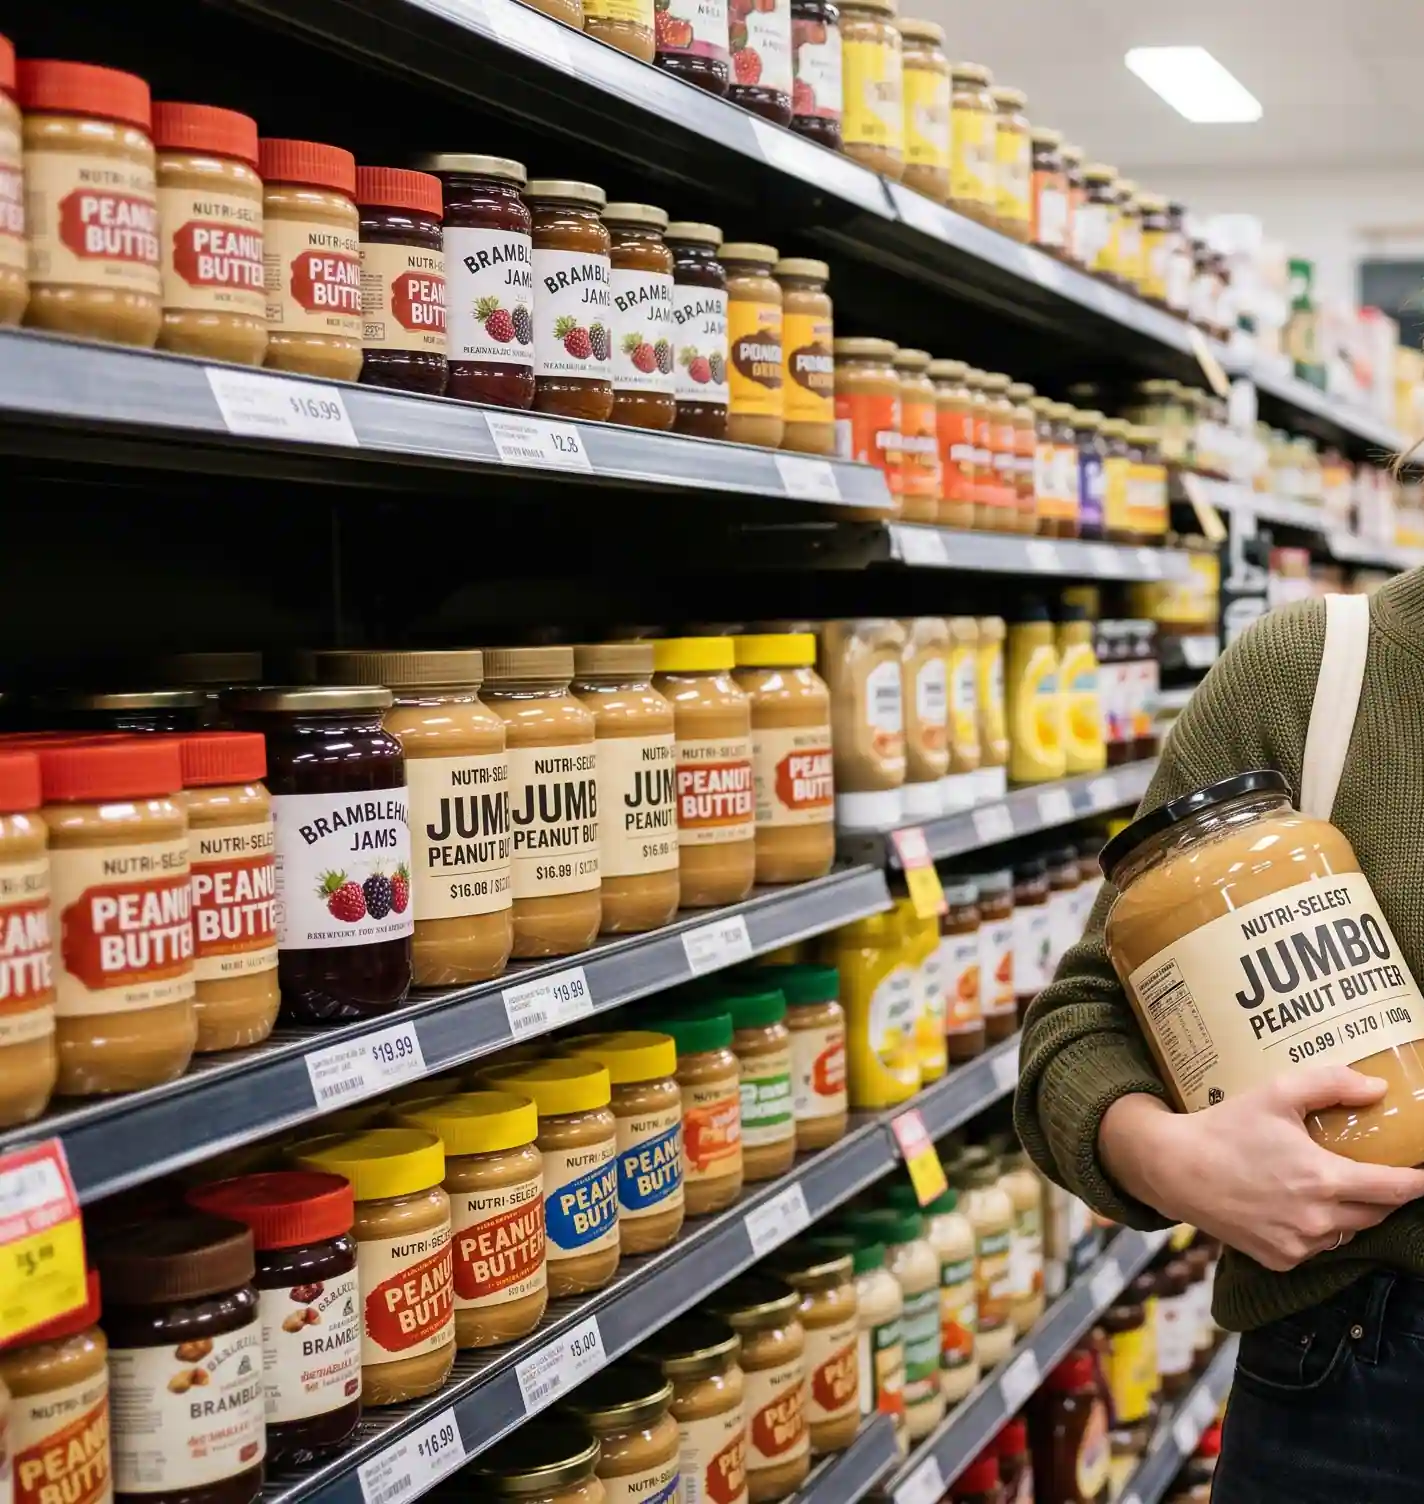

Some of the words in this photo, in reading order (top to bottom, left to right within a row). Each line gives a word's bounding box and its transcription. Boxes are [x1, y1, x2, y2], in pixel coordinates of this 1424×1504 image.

[290, 397, 342, 422] $16.99
[625, 808, 673, 832] PEANUT
[350, 828, 397, 852] JAMS
[513, 826, 580, 850] PEANUT
[428, 840, 496, 868] PEANUT
[1235, 912, 1391, 1010] JUMBO
[552, 979, 585, 1003] $19.99
[1248, 983, 1336, 1040] PEANUT
[1338, 964, 1406, 1001] BUTTER
[372, 1034, 414, 1064] $19.99
[1288, 1032, 1335, 1063] $10.99
[1344, 1015, 1378, 1040] $1.70
[460, 1204, 542, 1262] PEANUT
[472, 1231, 545, 1284] BUTTER
